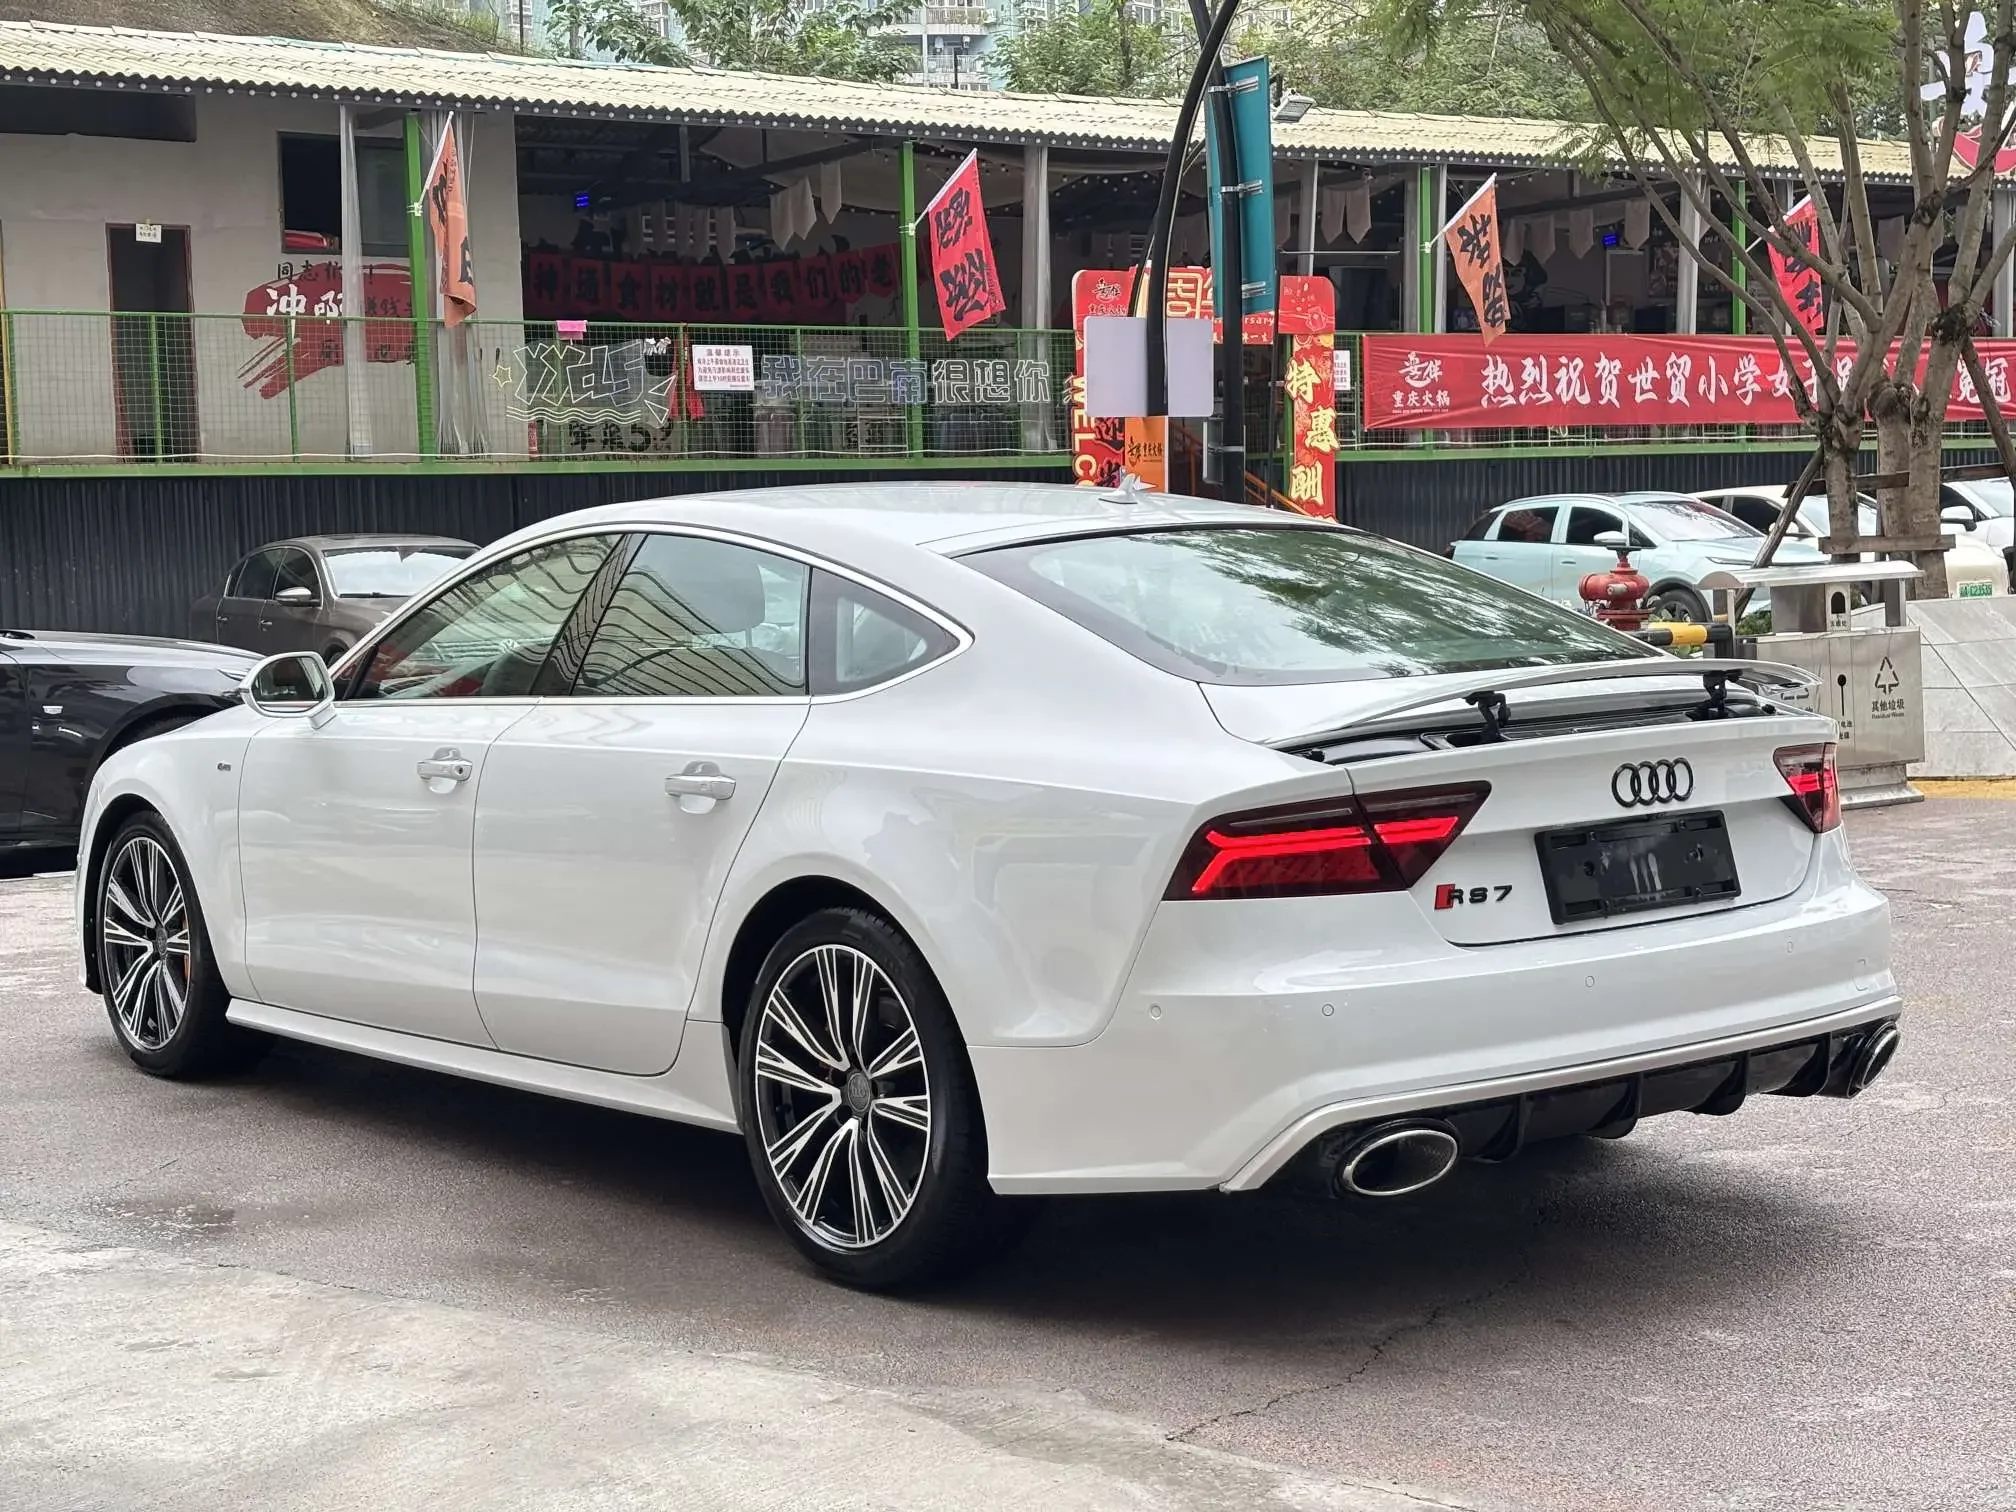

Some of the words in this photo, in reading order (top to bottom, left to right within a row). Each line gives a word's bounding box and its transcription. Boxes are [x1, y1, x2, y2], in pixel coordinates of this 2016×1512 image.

[1244, 317, 1274, 327] rsary
[760, 354, 1050, 404] 我在巴南很想你
[1391, 389, 1451, 408] 重庆火锅
[1073, 376, 1097, 487] WELC
[1285, 356, 1341, 523] 特惠酬
[1871, 698, 1905, 713] 其他垃圾
